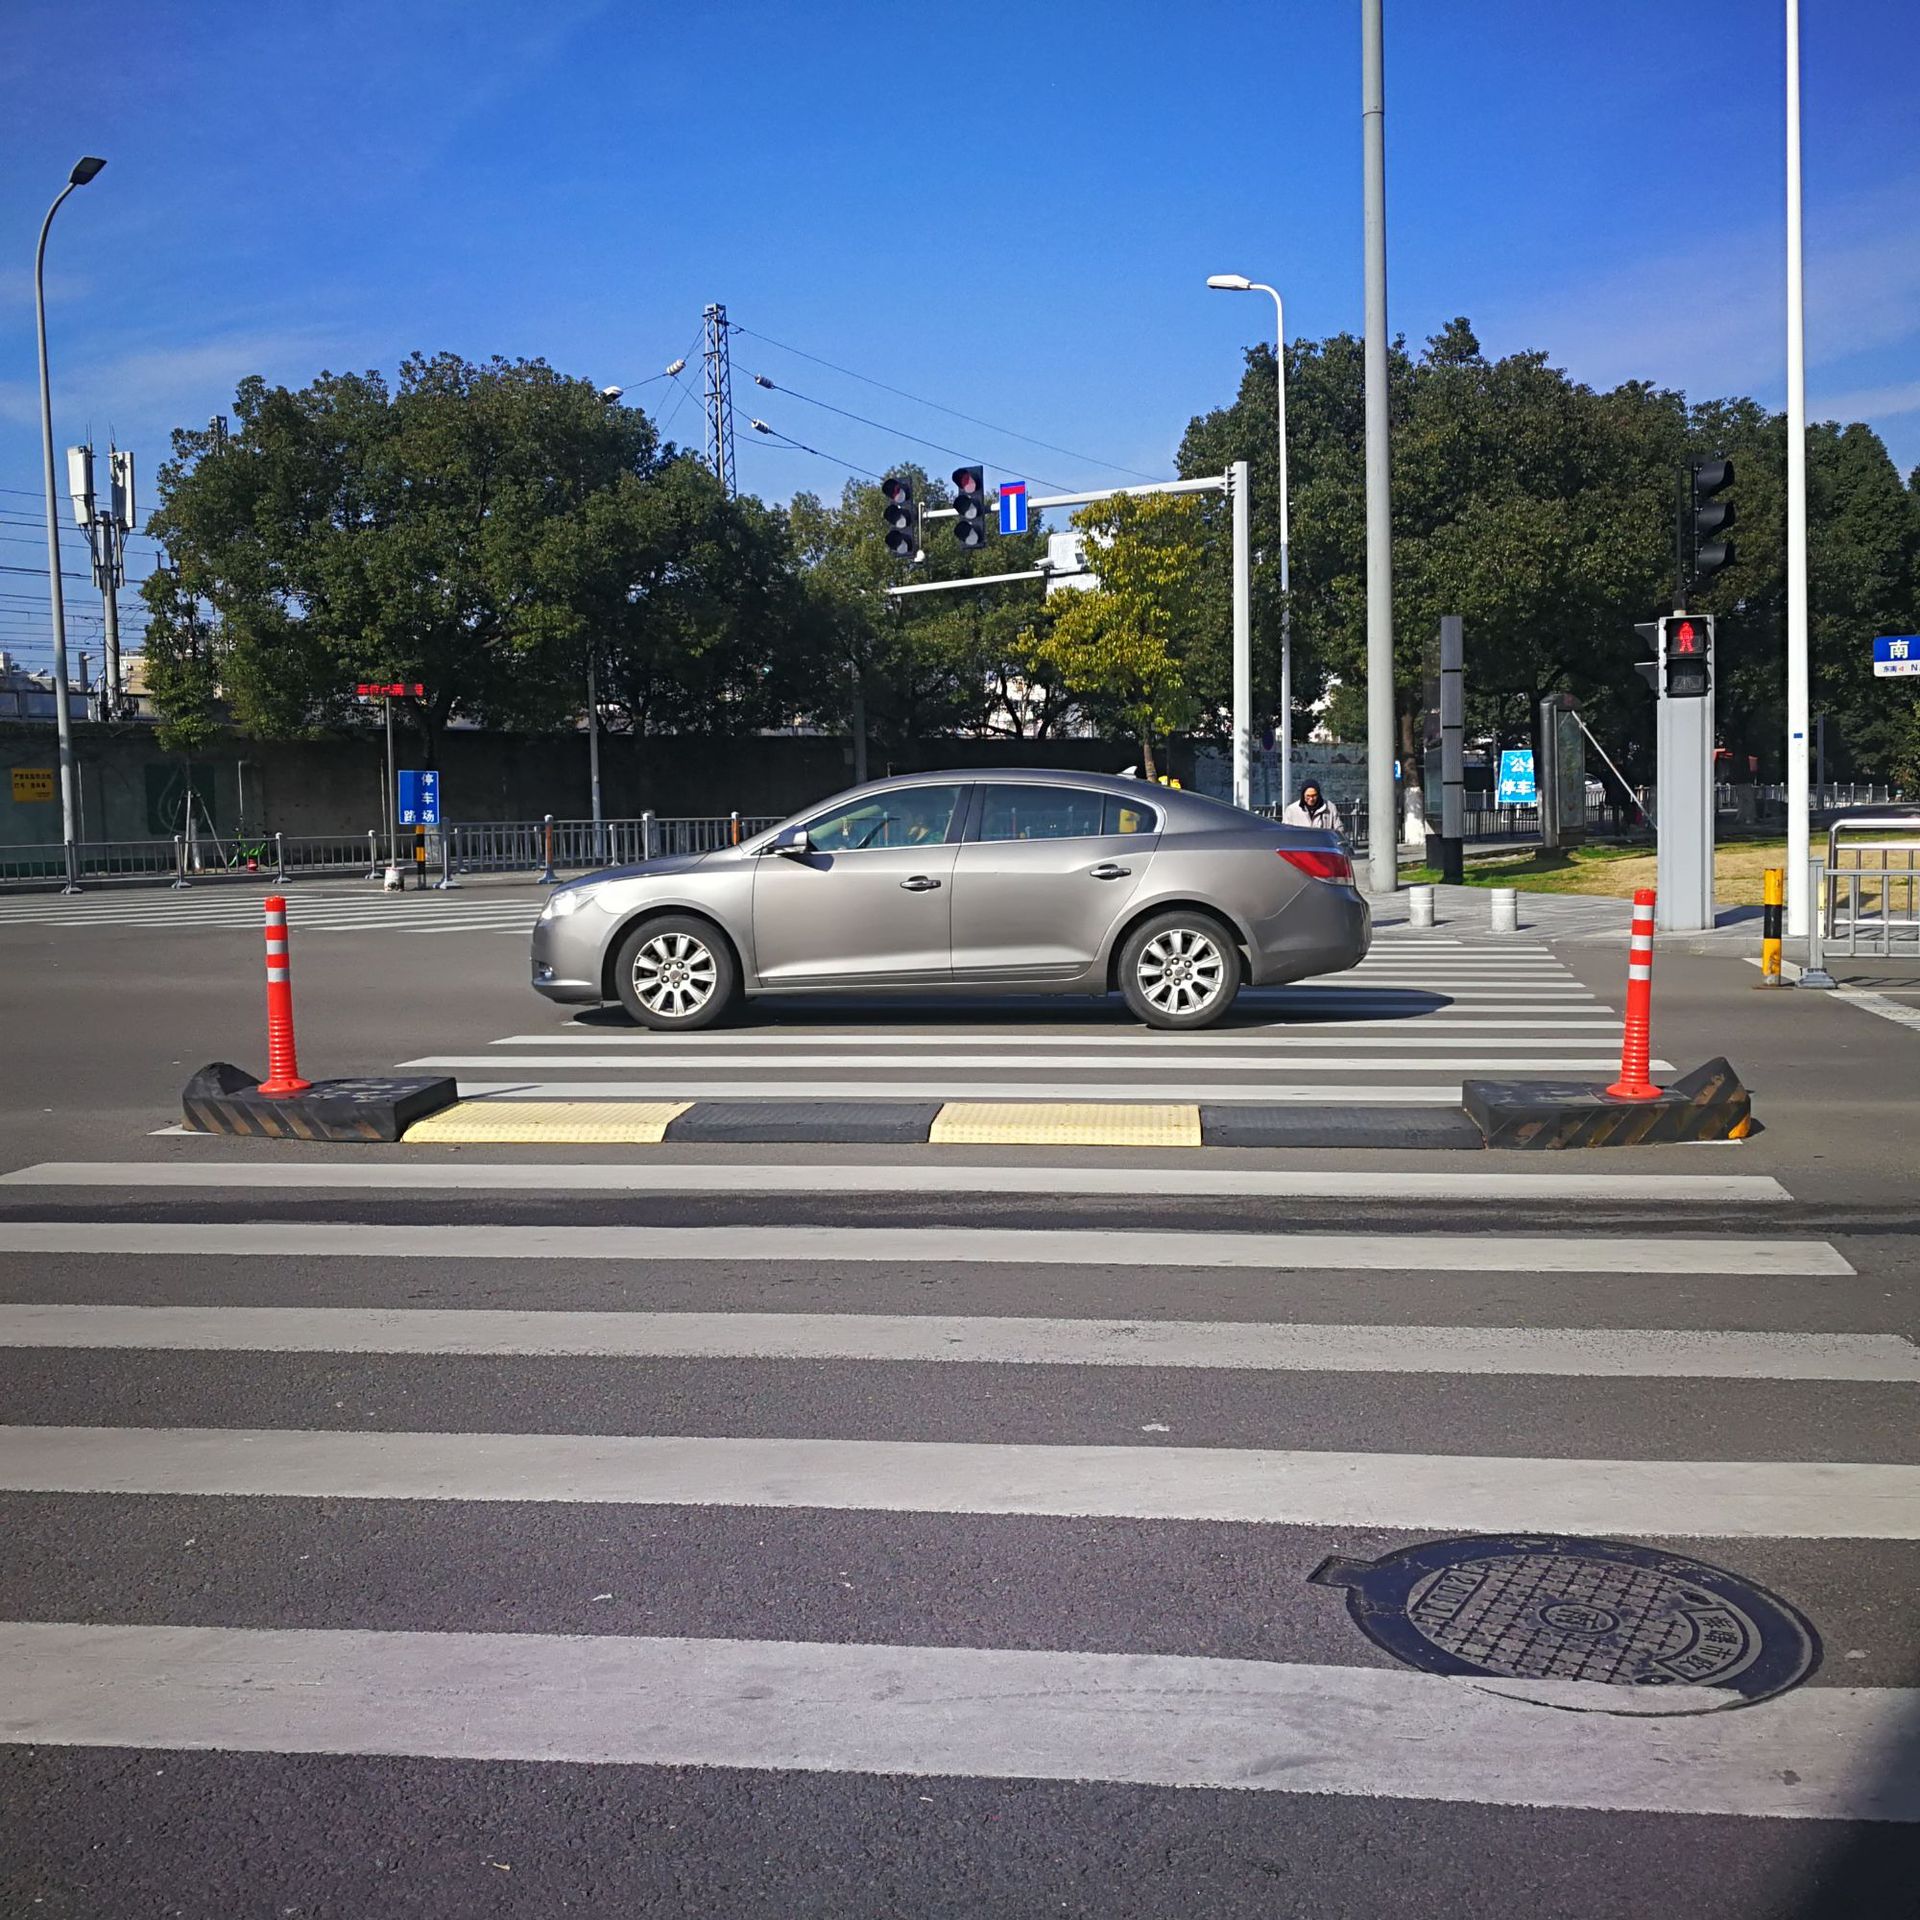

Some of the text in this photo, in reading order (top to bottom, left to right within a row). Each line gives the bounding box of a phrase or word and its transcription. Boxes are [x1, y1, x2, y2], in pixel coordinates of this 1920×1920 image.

[1888, 639, 1910, 659] 南
[1911, 663, 1920, 671] N
[1501, 779, 1536, 796] 停车
[421, 773, 435, 823] 停车场
